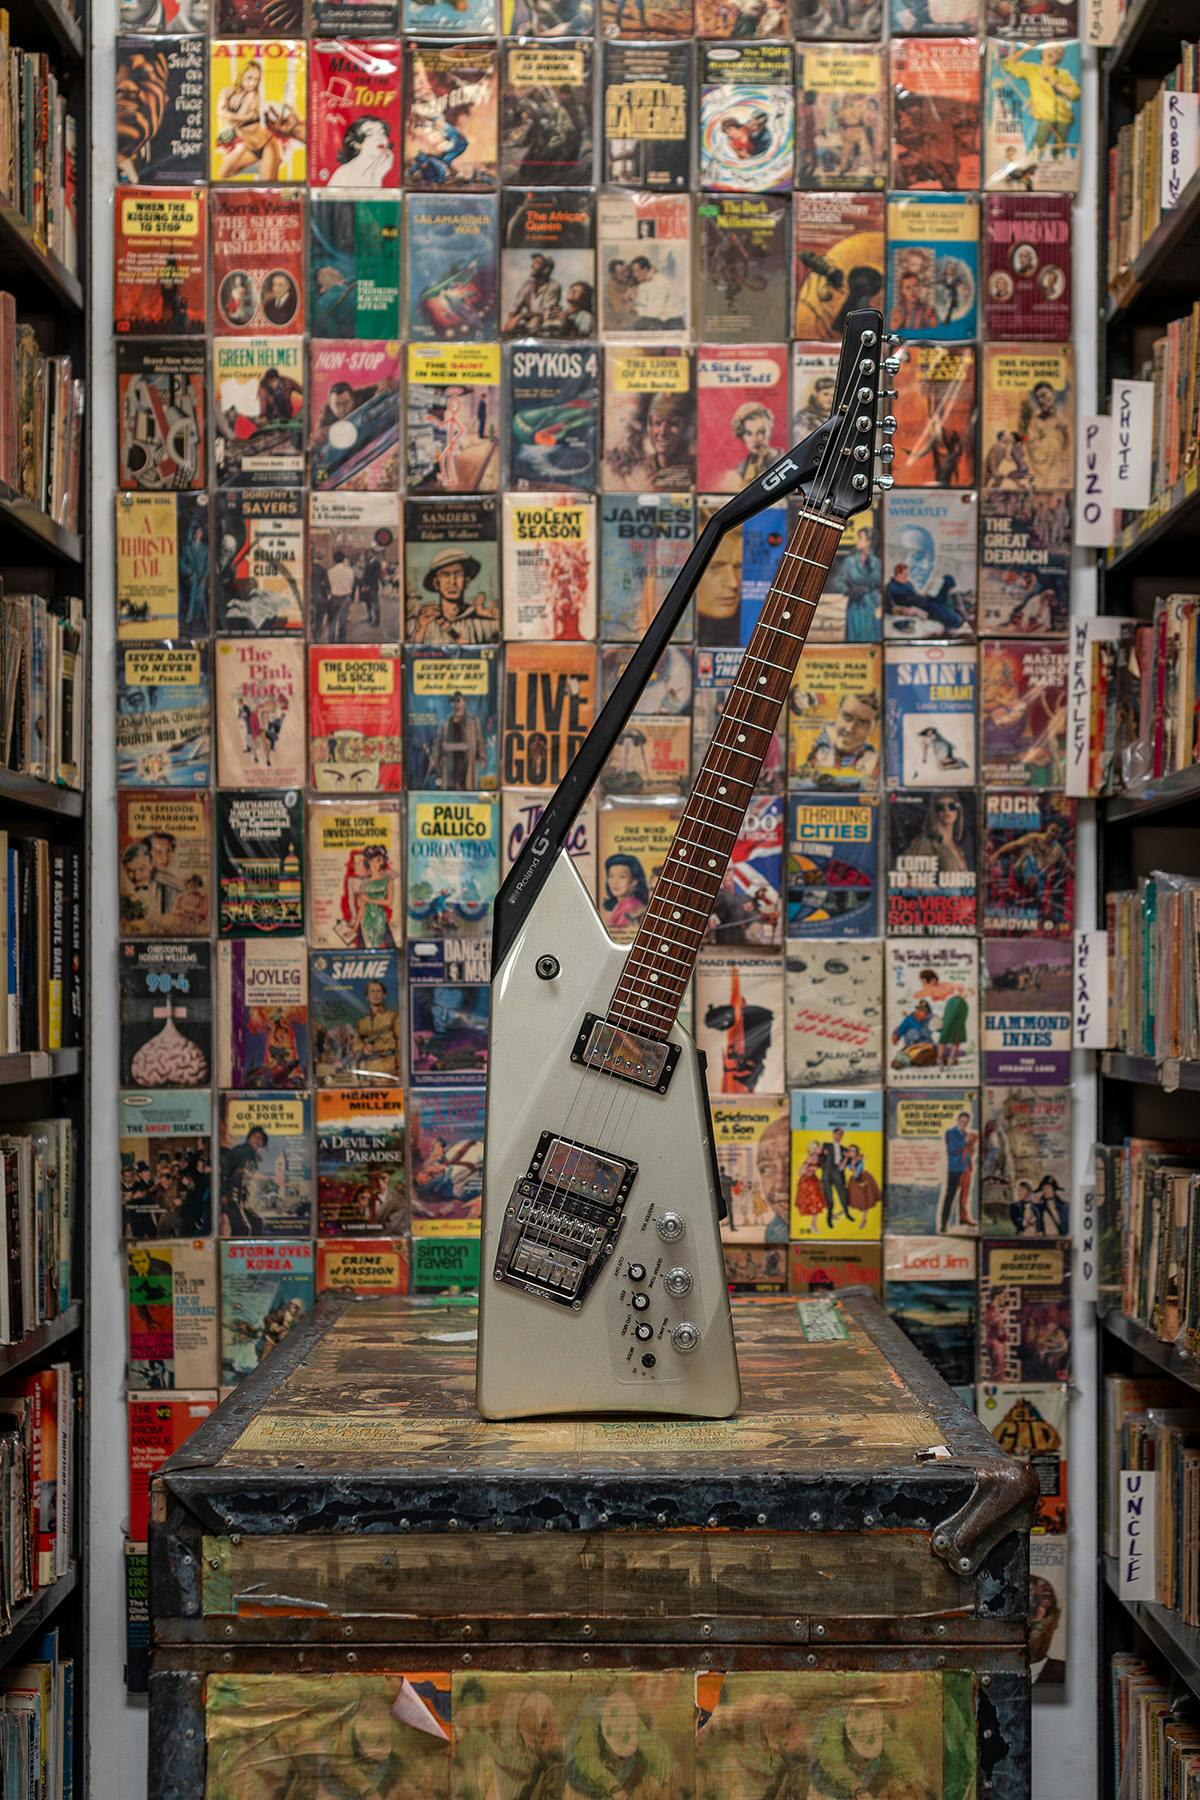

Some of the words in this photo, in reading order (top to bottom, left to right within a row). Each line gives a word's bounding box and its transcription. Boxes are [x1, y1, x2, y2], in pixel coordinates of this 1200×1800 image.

[180, 40, 202, 53] The
[168, 54, 202, 68] Snake
[186, 69, 201, 81] on
[181, 82, 202, 95] the
[354, 86, 397, 107] TOFF
[175, 97, 202, 111] Face
[187, 112, 202, 126] of
[180, 127, 202, 140] the
[170, 142, 202, 159] Tiger
[136, 203, 164, 211] WHEN
[168, 203, 186, 211] THE
[127, 212, 168, 221] KISSING
[172, 212, 193, 221] HAD
[216, 216, 249, 229] THE
[252, 216, 300, 229] SHOES
[414, 215, 490, 225] SALAMANDER
[526, 211, 545, 222] The
[550, 211, 589, 224] African
[140, 222, 153, 231] TO
[156, 222, 181, 231] STOP
[525, 222, 562, 232] Queen
[215, 241, 302, 255] FISHERMAN
[218, 349, 255, 367] GREEN
[257, 349, 298, 367] HELMET
[513, 352, 582, 378] SPYKOS
[585, 352, 598, 378] 4
[796, 357, 826, 367] Jack
[451, 362, 483, 370] SAINT
[622, 370, 637, 379] OF
[640, 370, 680, 379] SPARTA
[1120, 388, 1131, 481] SHUTE
[1083, 424, 1104, 525] PUZO
[242, 501, 298, 515] SAYERS
[889, 507, 948, 518] WHEATLEY
[422, 512, 477, 523] SANDERS
[516, 511, 583, 526] VIOLENT
[604, 508, 692, 524] JAMES
[143, 515, 152, 534] A
[986, 518, 1012, 532] THE
[517, 525, 582, 539] SEASON
[618, 524, 692, 540] BOND
[120, 535, 175, 557] THIRSTY
[985, 534, 1029, 548] GREAT
[253, 551, 296, 562] BELLONA
[985, 550, 1049, 565] DEBAUCH
[133, 559, 162, 579] EVIL
[253, 564, 279, 577] CLUB
[128, 654, 165, 662] SEVEN
[167, 654, 197, 662] DAYS
[237, 647, 272, 664] The
[132, 664, 149, 672] TO
[152, 664, 192, 672] NEVER
[250, 666, 292, 680] Pink
[324, 662, 344, 673] THE
[346, 662, 389, 673] DOCTOR
[805, 662, 841, 670] YOUNG
[846, 662, 868, 670] MAN
[337, 673, 348, 683] IS
[350, 673, 375, 683] SICK
[897, 665, 975, 686] SAINT
[242, 683, 294, 700] Hotel
[327, 685, 355, 693] Anthony
[357, 684, 386, 693] Burgess
[930, 686, 974, 701] ERRANT
[1074, 622, 1089, 765] WHEATLEY
[506, 672, 590, 732] LIVE
[140, 805, 152, 813] AN
[155, 805, 194, 813] EPISODE
[987, 795, 1041, 814] ROCK
[230, 809, 288, 818] HAWTHORNE
[433, 806, 474, 821] PAUL
[802, 807, 870, 824] THRILLING
[334, 817, 351, 827] THE
[354, 817, 375, 827] LOVE
[323, 828, 388, 838] INVESTIGATOR
[421, 822, 487, 837] GALLICO
[800, 824, 869, 839] CITIES
[412, 841, 496, 859] CORONATION
[897, 856, 939, 872] COME
[515, 856, 540, 892] Roland
[888, 872, 909, 889] TO
[910, 872, 938, 889] THE
[940, 872, 976, 889] WAR
[889, 896, 919, 911] The
[921, 896, 976, 911] VIRGIN
[888, 911, 976, 926] SOLDIERS
[888, 925, 926, 936] LESLIE
[928, 925, 976, 936] THOMAS
[1079, 934, 1089, 967] THE
[246, 968, 302, 986] JOYLEG
[332, 960, 389, 980] SHANE
[1077, 973, 1091, 1044] SAINT
[985, 1015, 1071, 1030] HAMMOND
[1002, 1032, 1053, 1047] INNES
[340, 1091, 389, 1101] HENRY
[247, 1104, 284, 1112] KINGS
[349, 1102, 402, 1111] MILLER
[901, 1104, 941, 1112] SATURDAY
[943, 1103, 965, 1112] NIGHT
[237, 1113, 252, 1121] GO
[127, 1125, 144, 1133] THE
[145, 1124, 172, 1133] ANGRY
[173, 1123, 205, 1132] SILENCE
[721, 1125, 731, 1135] &
[732, 1123, 755, 1135] Son
[319, 1139, 329, 1149] A
[332, 1136, 369, 1149] DEVIL
[372, 1137, 386, 1149] IN
[345, 1150, 402, 1163] PARADISE
[1084, 1192, 1094, 1280] BOND
[228, 1248, 275, 1259] STORM
[277, 1247, 312, 1258] OVER
[417, 1243, 469, 1258] simon
[1012, 1253, 1040, 1262] LOST
[246, 1259, 293, 1271] KOREA
[341, 1256, 382, 1265] CRIME
[417, 1256, 463, 1270] raven
[903, 1253, 941, 1270] Lord
[944, 1253, 969, 1270] Jim
[1001, 1263, 1053, 1271] HORIZON
[330, 1268, 341, 1276] of
[344, 1266, 395, 1275] PASSION
[131, 1404, 153, 1414] THE
[1014, 1407, 1038, 1421] EL
[131, 1415, 154, 1424] GIRL
[131, 1425, 163, 1435] FROM
[1000, 1421, 1063, 1450] CID
[131, 1436, 173, 1446] UNCLE
